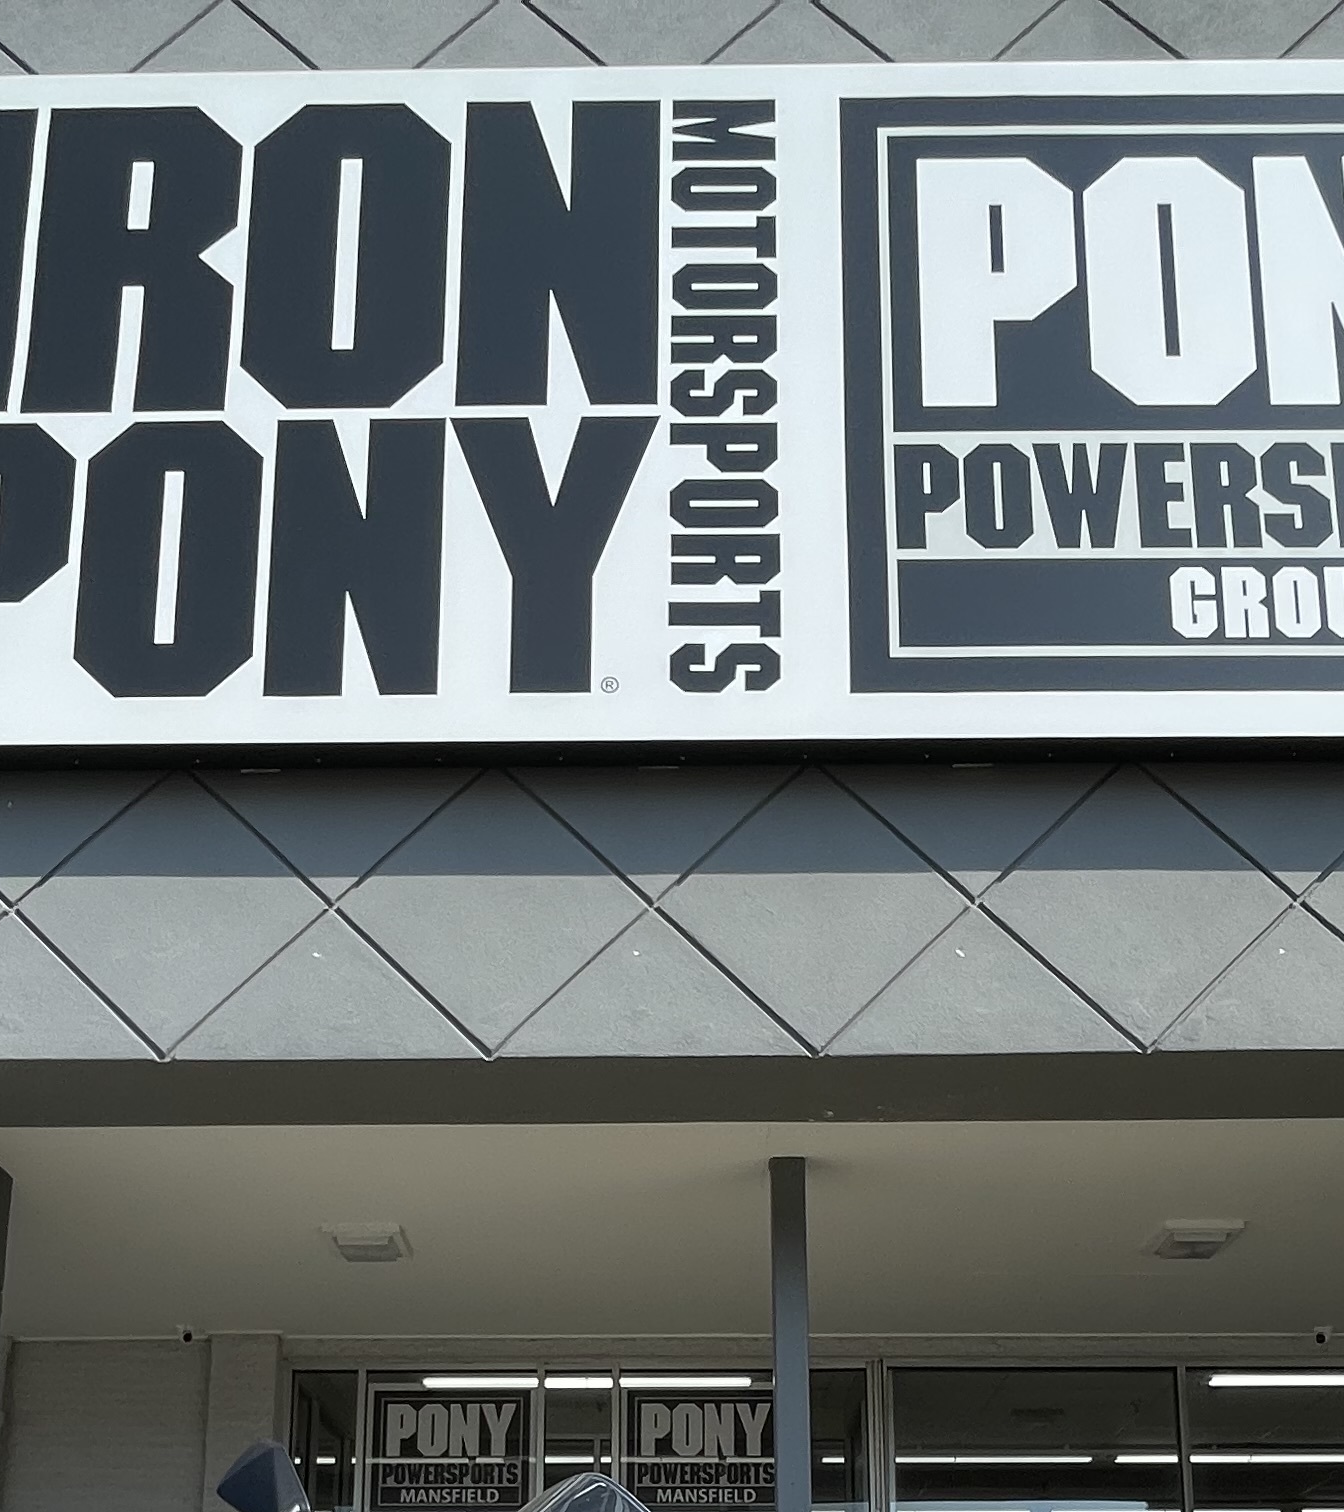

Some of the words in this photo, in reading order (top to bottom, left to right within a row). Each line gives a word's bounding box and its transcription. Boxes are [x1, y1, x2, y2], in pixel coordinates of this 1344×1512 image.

[668, 100, 781, 692] MOTORSPORTS
[386, 1403, 517, 1457] PONY
[641, 1403, 771, 1457] PONY
[381, 1463, 519, 1485] POWERSPORTS
[637, 1463, 775, 1485] POWERSPORTS
[400, 1489, 499, 1503] MANSFIELD
[656, 1489, 757, 1503] MANSFIELD
